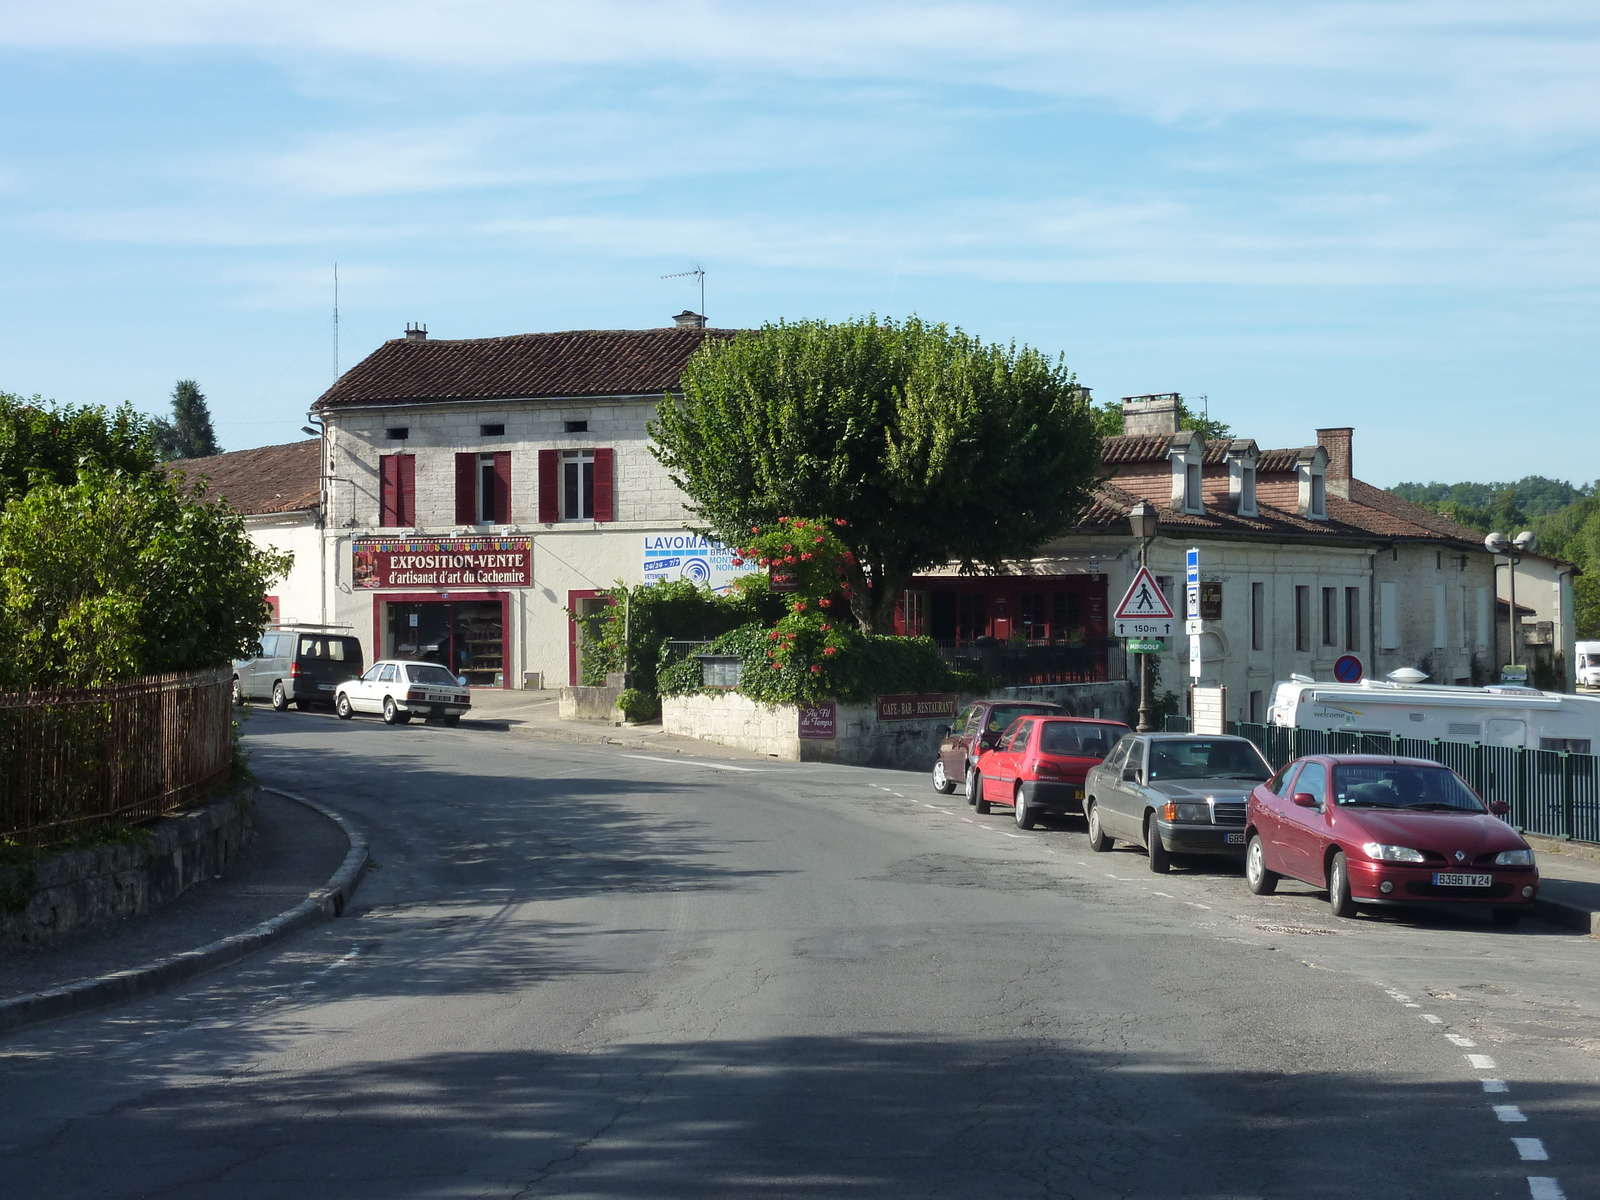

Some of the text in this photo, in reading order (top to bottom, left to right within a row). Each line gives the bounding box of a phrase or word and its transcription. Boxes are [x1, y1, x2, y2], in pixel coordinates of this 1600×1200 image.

[390, 554, 524, 569] EXPOSITION-VENTE
[644, 561, 663, 571] 24/24
[669, 558, 680, 567] 7/7
[389, 568, 525, 584] d'artisanat d'art du Cachemire
[805, 708, 831, 718] Au Fil
[901, 702, 913, 715] BAR
[917, 701, 954, 714] RESTAURANT
[1314, 707, 1345, 718] welcome
[801, 717, 833, 728] du Temps
